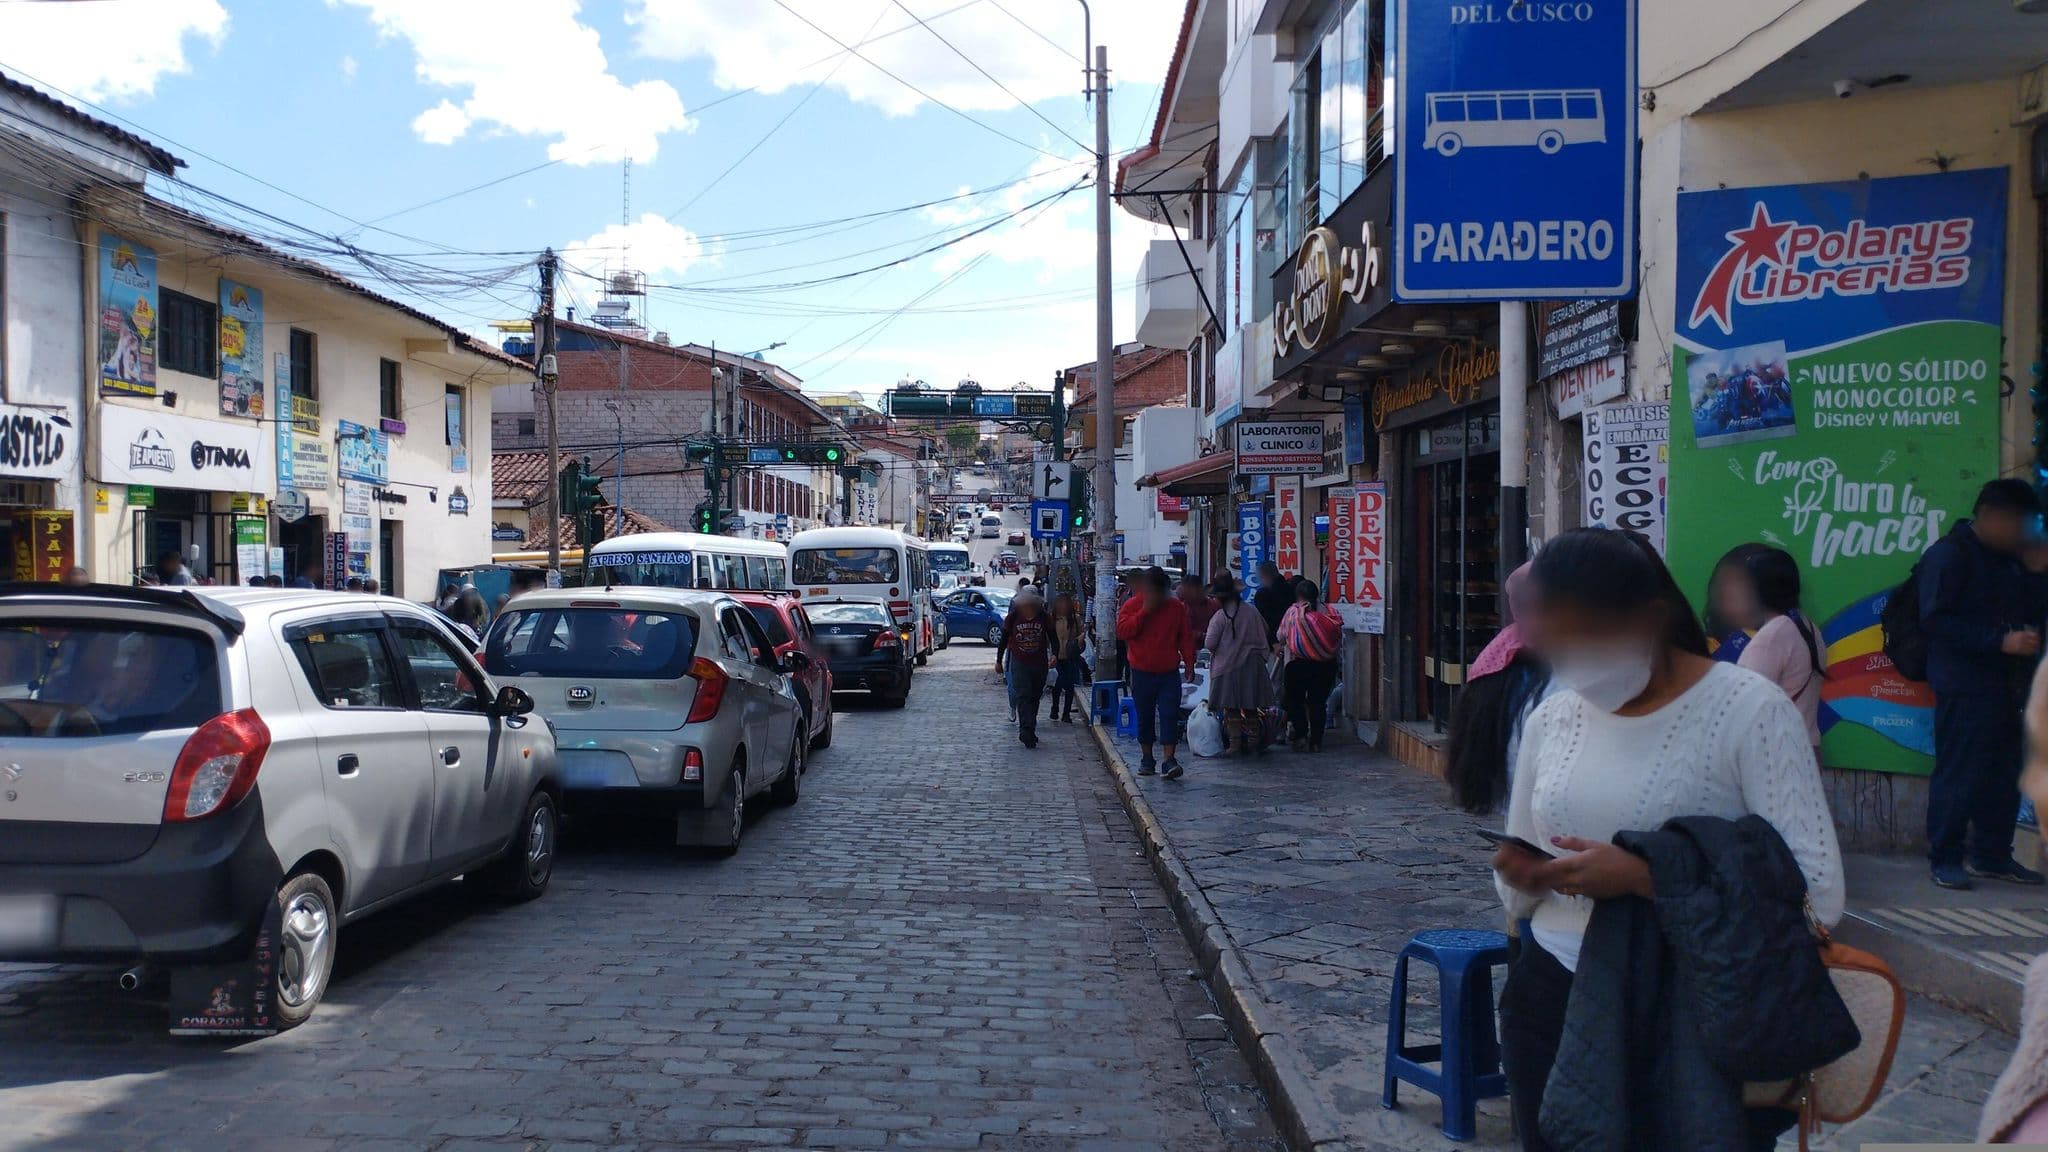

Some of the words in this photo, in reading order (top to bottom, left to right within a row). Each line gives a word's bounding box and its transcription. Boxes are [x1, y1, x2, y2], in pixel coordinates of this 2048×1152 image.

[1451, 5, 1501, 24] DEL
[1507, 2, 1593, 23] CUSCO
[1413, 220, 1614, 263] PARADERO
[1785, 217, 1973, 268] Polarys
[1559, 358, 1615, 403] DENTAL
[1812, 360, 1892, 385] NUEVO
[1898, 357, 1987, 383] SÓLIDO
[1813, 387, 1957, 409] MONOCOLOR
[1605, 404, 1670, 425] ANÁLISIS
[280, 388, 290, 477] DENTAL
[1241, 425, 1321, 436] LABORATORIO
[1260, 440, 1304, 450] CLINICO
[133, 449, 143, 467] TE
[143, 450, 175, 470] APUESTO
[1755, 450, 1800, 485] Con
[857, 488, 865, 522] DENTAL
[867, 493, 875, 524] DENTAL
[1833, 475, 1894, 513] loro
[1901, 483, 1926, 515] la
[1357, 491, 1383, 608] DENTA
[1810, 510, 1947, 568] haces
[335, 534, 345, 589] ECOGRA
[588, 552, 635, 568] EXPRESO
[636, 552, 691, 566] SANTIAGO
[570, 688, 589, 698] KIA
[1872, 716, 1914, 729] FROZEN
[123, 771, 165, 783] 800
[181, 1017, 245, 1028] CORAZON
